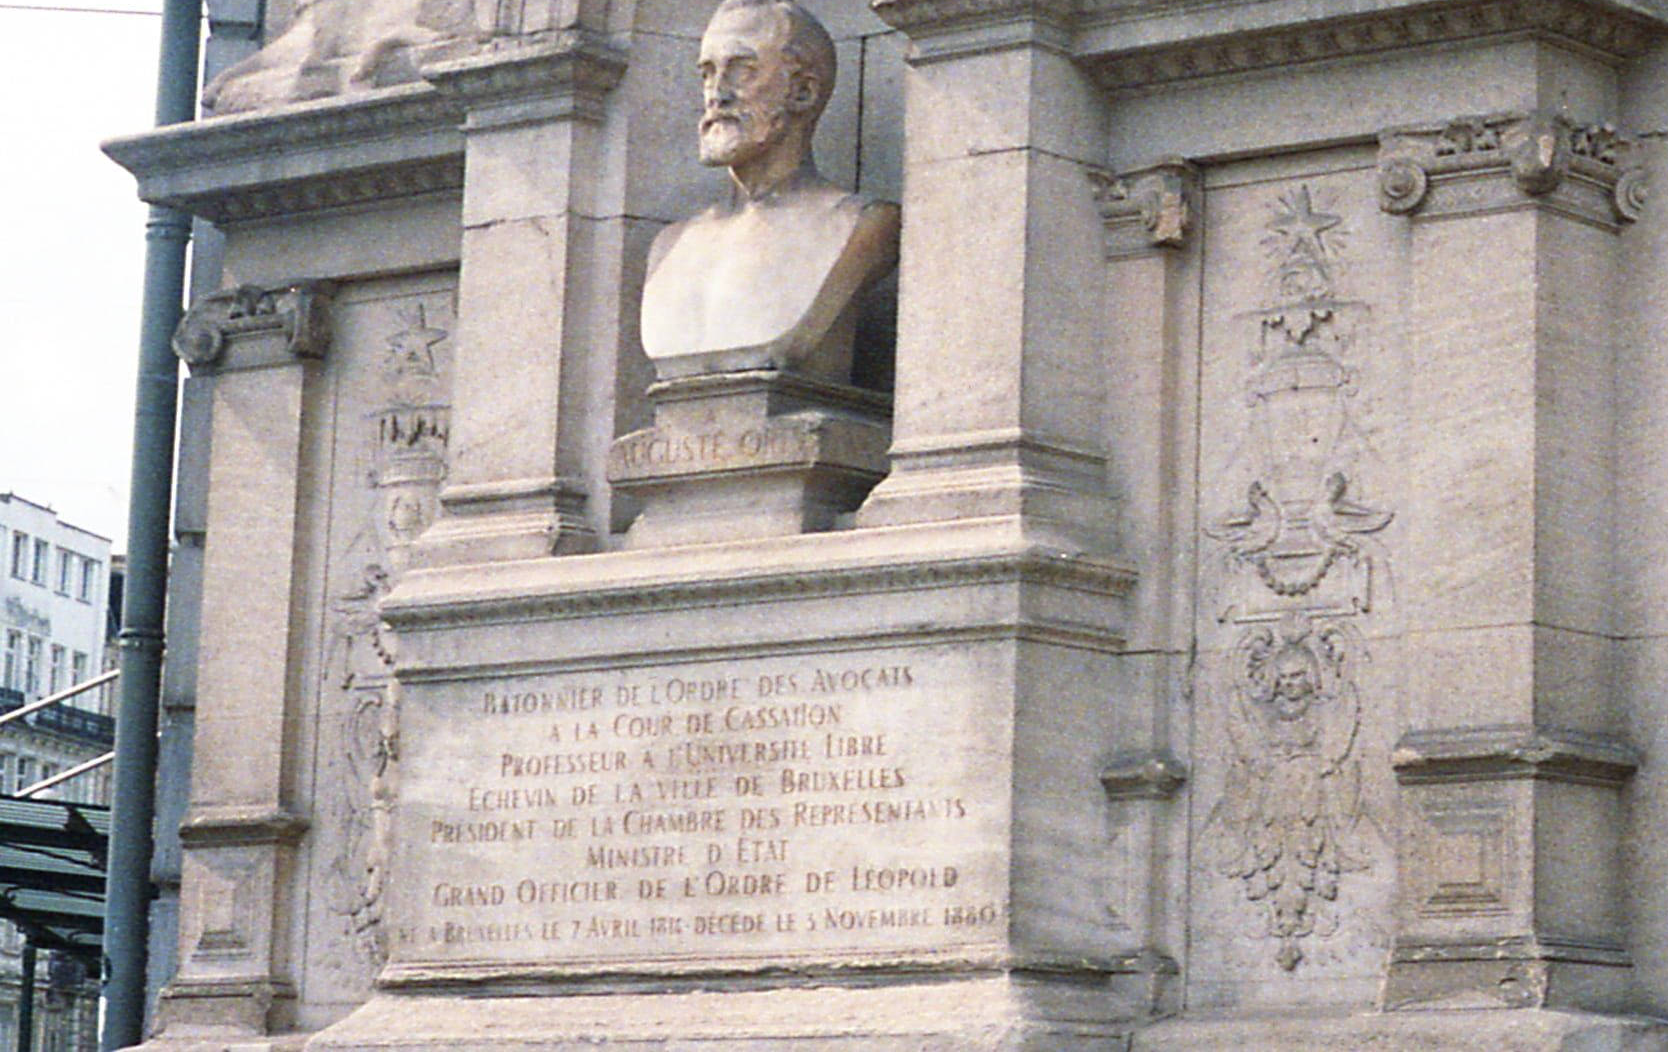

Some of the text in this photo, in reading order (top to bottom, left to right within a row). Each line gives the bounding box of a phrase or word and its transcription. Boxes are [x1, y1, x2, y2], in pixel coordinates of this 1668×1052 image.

[616, 684, 640, 707] DE
[757, 674, 798, 698] DES
[612, 713, 673, 738] COUR
[686, 712, 714, 735] DE
[500, 749, 628, 778] PROFESSEUR
[826, 733, 888, 759] LIBRE
[571, 784, 598, 807] DE
[614, 782, 643, 804] LA
[734, 775, 766, 798] DE
[780, 768, 905, 794] BRUXELLES
[553, 818, 579, 840] DE
[591, 815, 614, 837] LA
[622, 808, 727, 835] CHAMBRE
[740, 807, 781, 831] DES
[585, 844, 687, 869] MINISTRE
[432, 882, 506, 907] GRAND
[516, 878, 618, 904] OFFICIER
[638, 877, 668, 900] DE
[806, 871, 836, 894] DE
[541, 920, 562, 941] LE
[776, 912, 797, 933] LE
